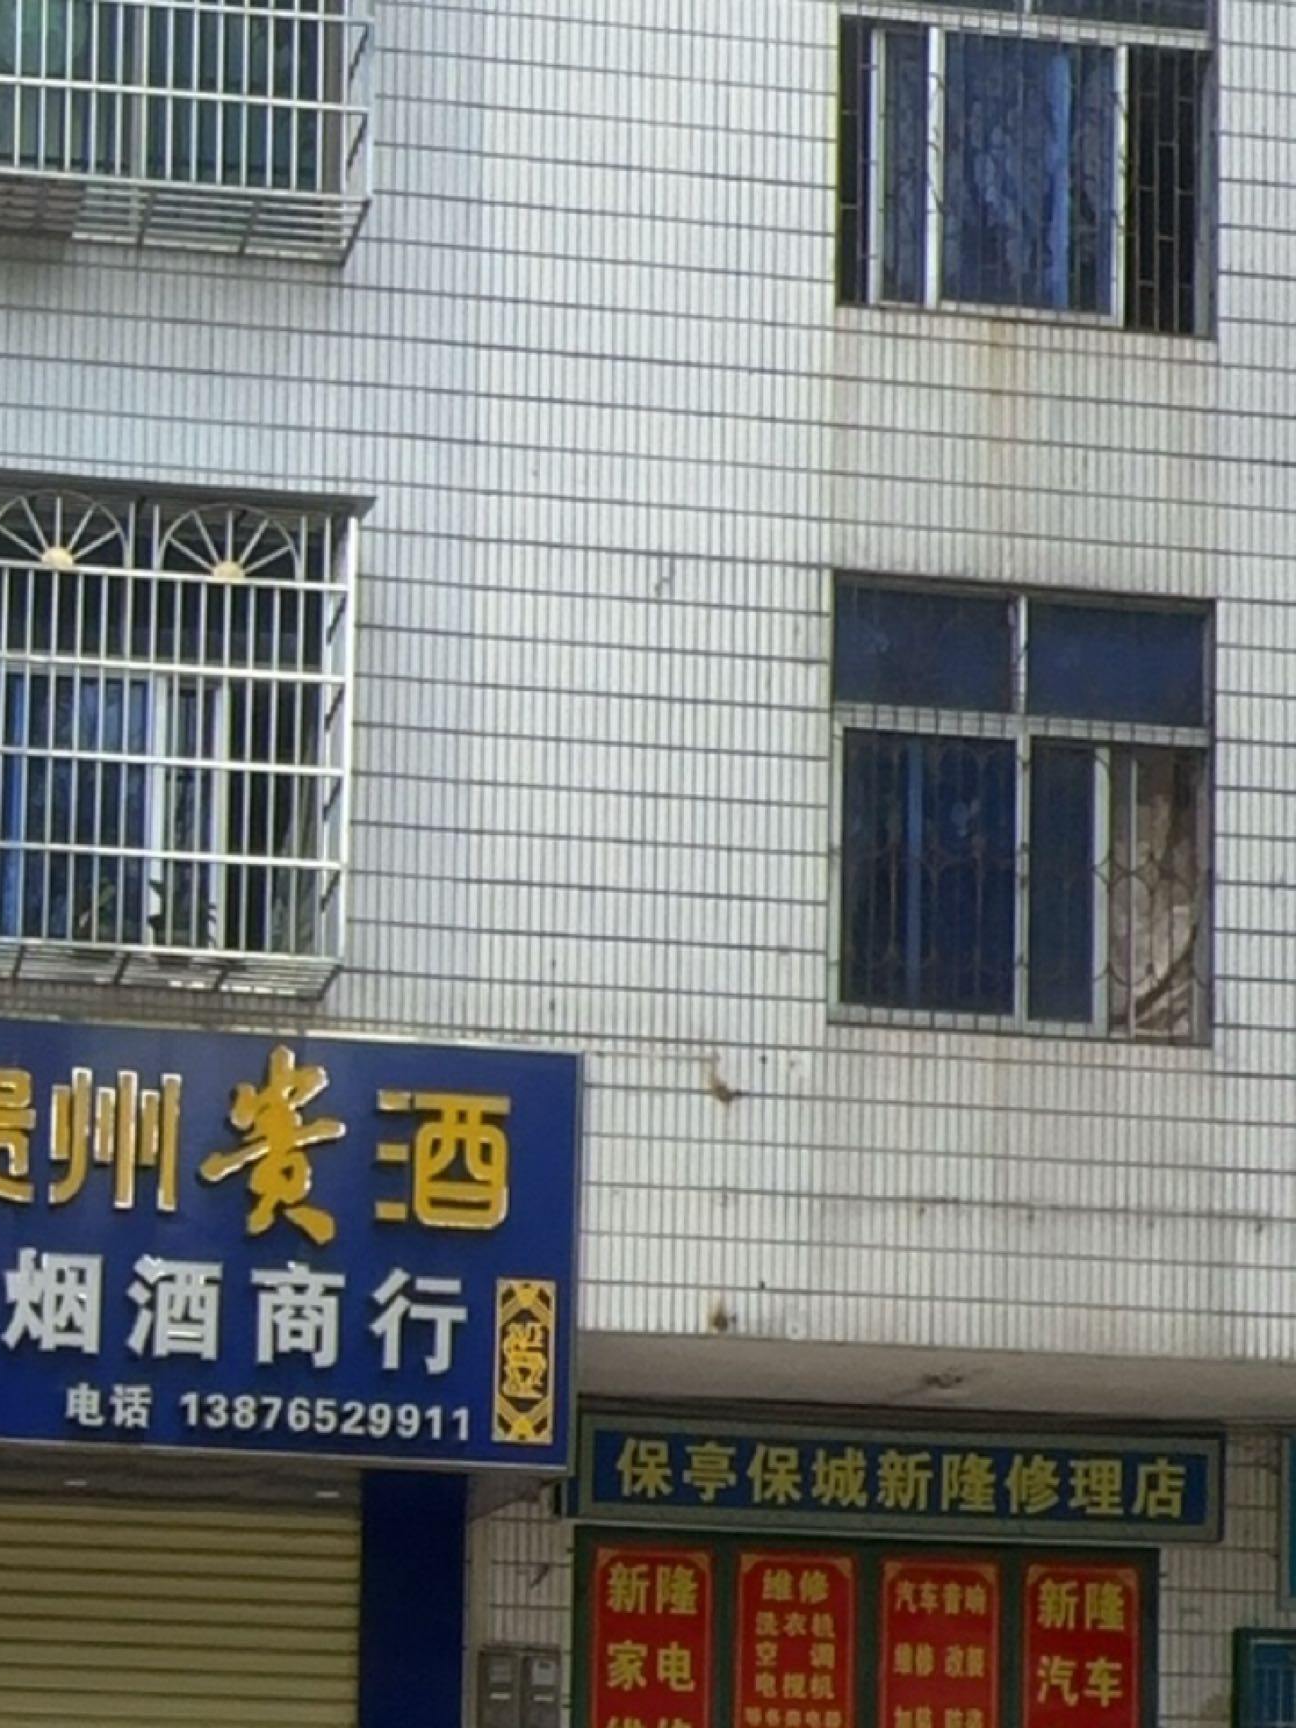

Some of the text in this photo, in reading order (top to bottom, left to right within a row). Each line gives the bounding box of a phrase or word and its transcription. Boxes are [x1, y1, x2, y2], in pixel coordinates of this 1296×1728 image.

[65, 1382, 471, 1441] 电话 13876529911
[616, 1436, 1188, 1519] 保亭保城新隆修理店
[606, 1561, 698, 1616] 新隆
[762, 1568, 830, 1604] 维修
[1036, 1577, 1125, 1631] 新隆
[755, 1611, 835, 1638] 洗衣机
[606, 1640, 696, 1693] 家电
[755, 1671, 835, 1700] 电视机
[1036, 1655, 1123, 1708] 汽车
